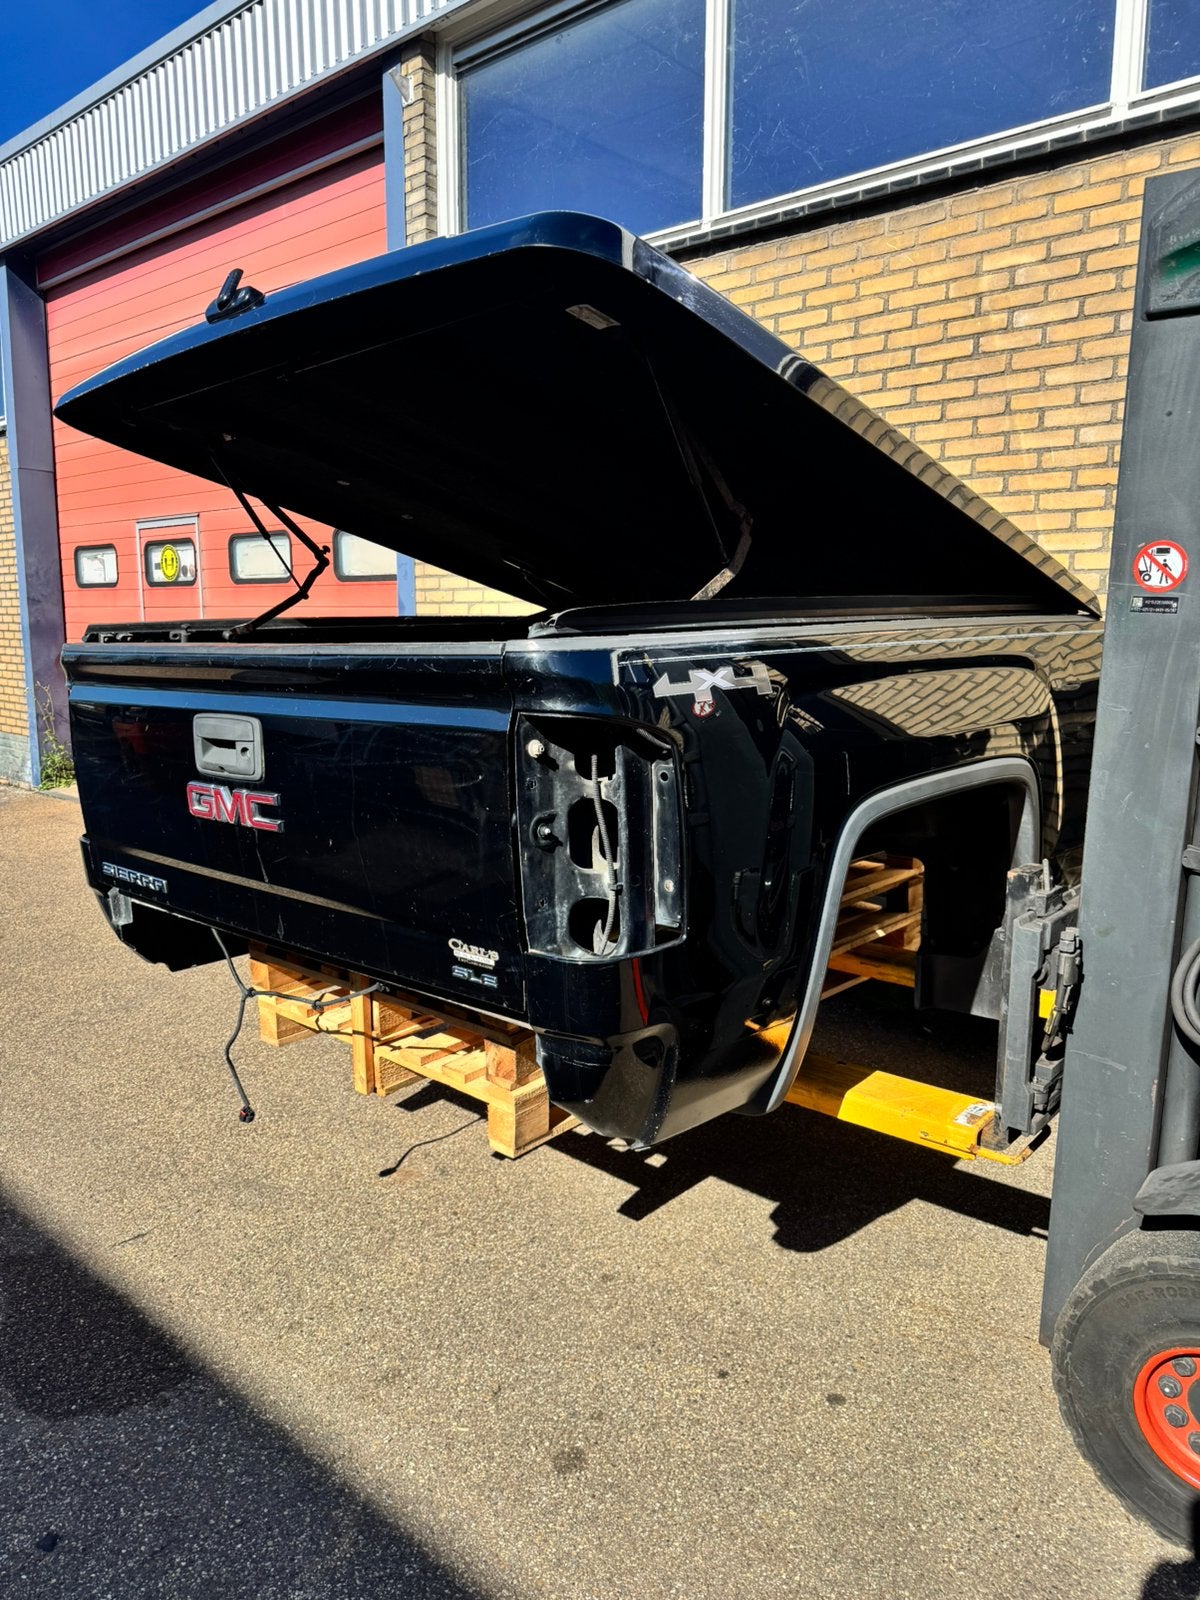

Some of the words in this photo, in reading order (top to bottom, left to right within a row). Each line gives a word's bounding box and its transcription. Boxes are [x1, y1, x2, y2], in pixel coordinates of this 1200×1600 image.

[187, 781, 285, 832] GMC
[102, 862, 168, 894] SIERRA
[452, 965, 498, 989] SLE
